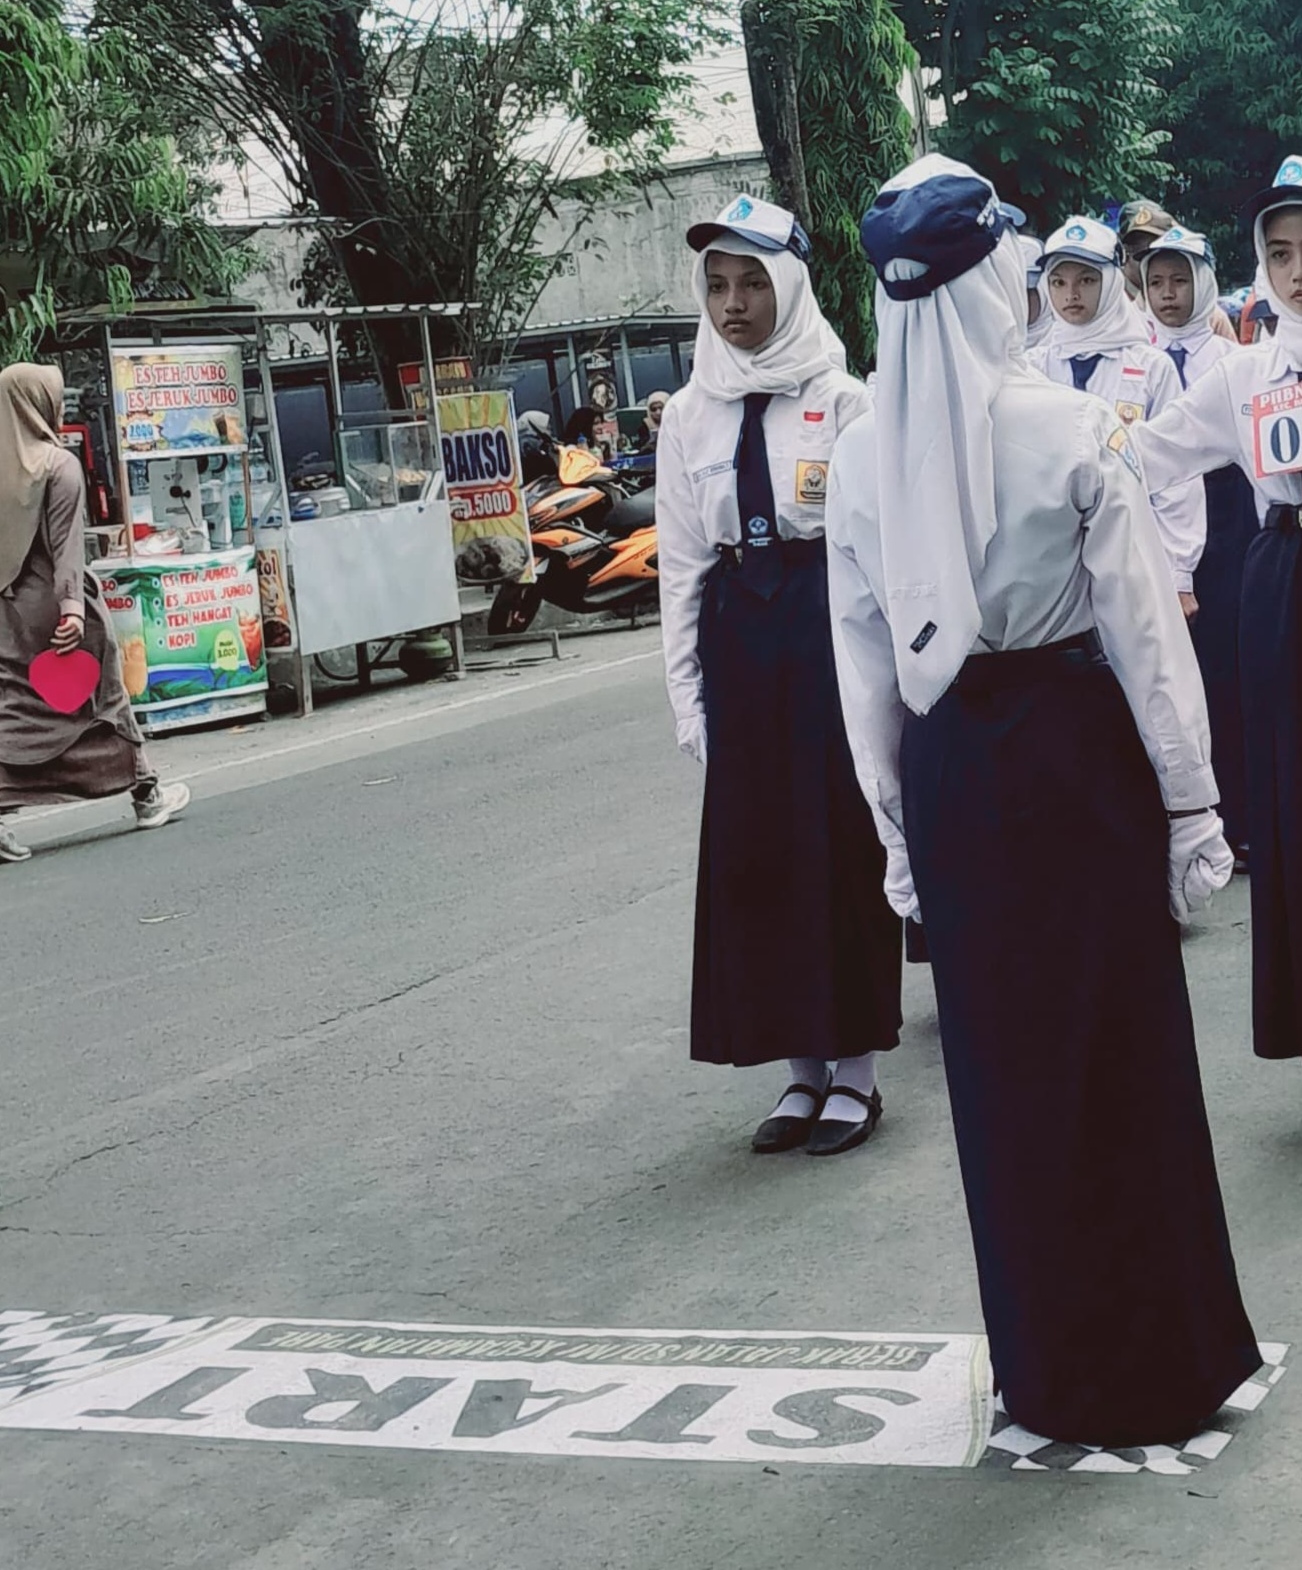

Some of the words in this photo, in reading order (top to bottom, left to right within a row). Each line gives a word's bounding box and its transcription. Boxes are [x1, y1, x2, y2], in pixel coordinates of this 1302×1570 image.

[134, 365, 151, 384] ES
[154, 364, 180, 383] TEH
[184, 364, 227, 382] JUMBO
[128, 389, 145, 409] ES
[148, 388, 191, 408] JERUK
[195, 386, 237, 405] JUMBO
[441, 430, 511, 483] BAKSO
[162, 575, 176, 588] ES
[179, 572, 199, 585] TEH
[203, 566, 239, 582] JUMBO
[165, 594, 179, 608] ES
[184, 589, 217, 606] JERUK
[221, 584, 254, 600] JUMBO
[167, 614, 189, 628] TEH
[192, 607, 233, 624] HANGAT
[168, 633, 195, 647] KOPI
[258, 1330, 352, 1351] PARE
[680, 1342, 799, 1365] JALAN
[794, 1344, 919, 1367] GERAK
[82, 1366, 922, 1450] START
